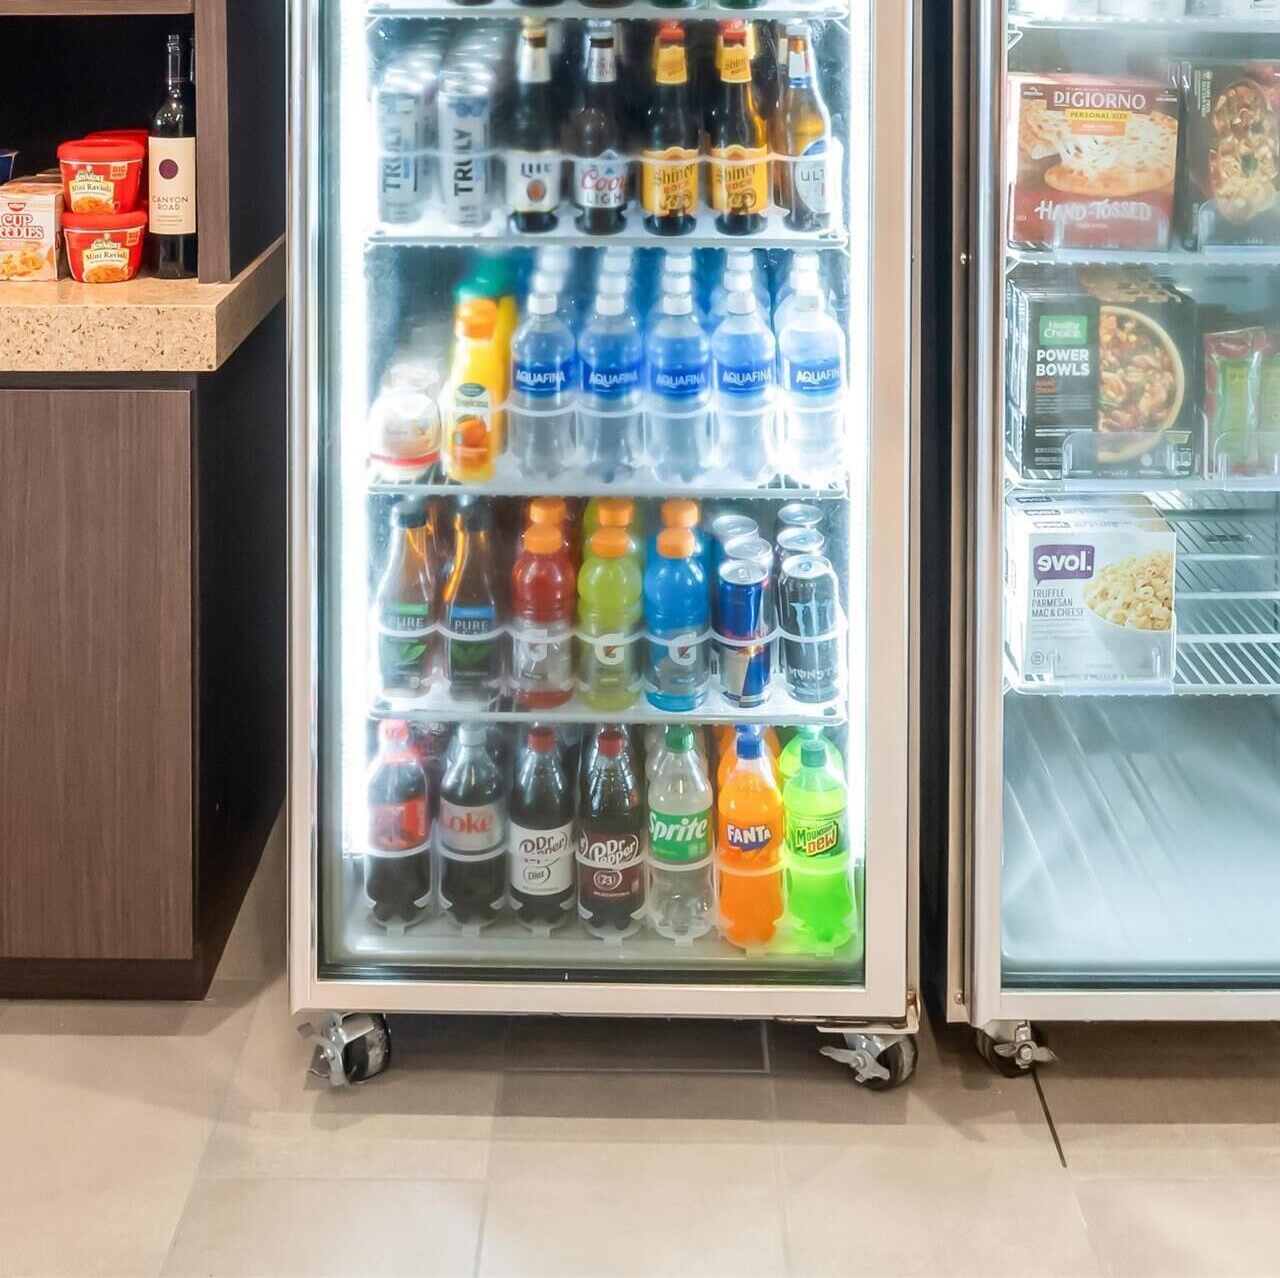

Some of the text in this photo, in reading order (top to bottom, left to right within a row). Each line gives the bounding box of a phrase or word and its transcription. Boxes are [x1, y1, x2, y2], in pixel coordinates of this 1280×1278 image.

[653, 162, 696, 184] Shiner
[152, 196, 188, 204] CANYON
[1, 213, 33, 227] CUP
[1036, 349, 1089, 361] POWER
[1036, 363, 1090, 377] BOWLS
[516, 370, 566, 387] AQUAFINA
[588, 371, 638, 387] AQUAFINA
[655, 372, 705, 389] AQUAFINA
[722, 370, 773, 386] AQUAFINA
[796, 370, 841, 386] AQUAFIN
[1032, 588, 1065, 598] TRUFFLE
[1032, 598, 1073, 608] PARMESAN
[1032, 608, 1049, 617] MAC
[1049, 608, 1056, 617] &
[454, 620, 489, 631] PURE
[649, 812, 708, 844] Sprite
[727, 824, 771, 844] FANTA
